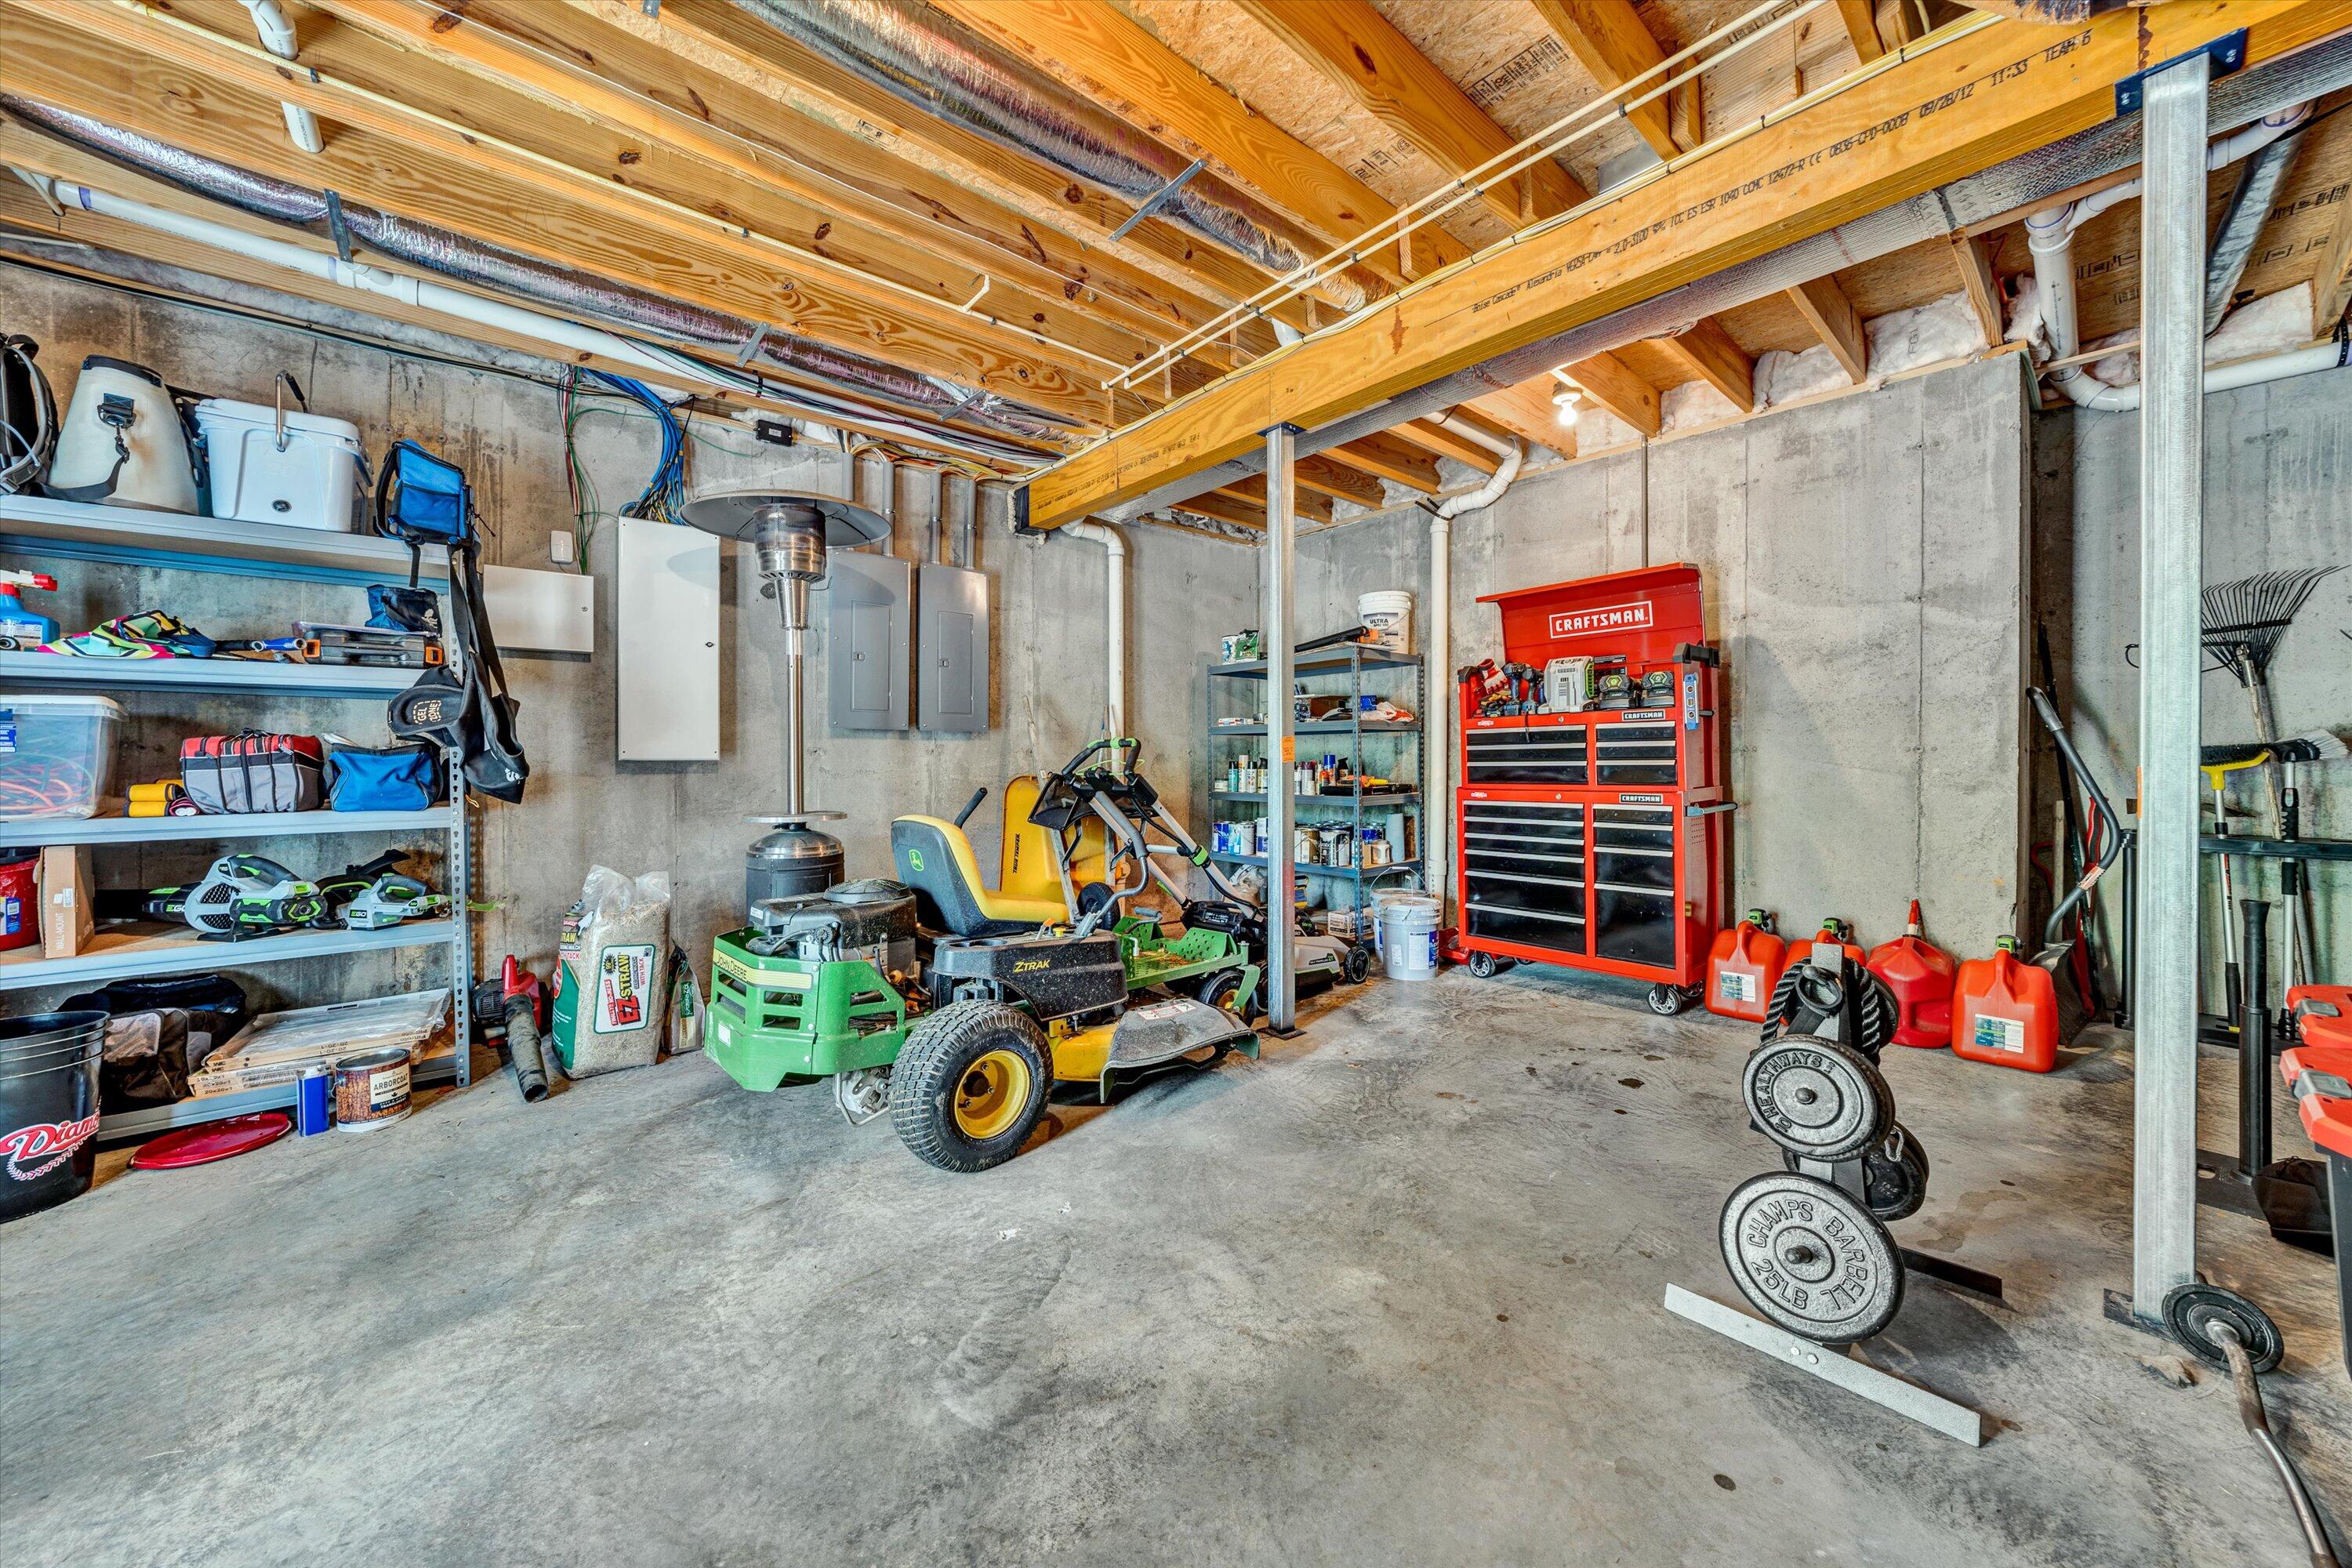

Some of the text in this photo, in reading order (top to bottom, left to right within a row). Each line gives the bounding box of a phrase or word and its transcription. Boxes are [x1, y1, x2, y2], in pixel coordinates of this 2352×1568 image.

[1526, 269, 1563, 292] Alexandria
[1686, 205, 1697, 221] ES
[1700, 198, 1715, 214] ESR
[1991, 58, 2029, 88] 11:33
[1555, 608, 1646, 632] CRAFTSMAN
[416, 707, 428, 721] GEL
[427, 703, 439, 721] ZONE
[1624, 711, 1664, 720] CRAFTSMAN
[56, 912, 65, 951] WALL-MOUNT
[717, 953, 747, 980] JOHN DEERE
[1014, 959, 1051, 974] ZTRAK
[373, 1073, 408, 1091] ARBORCOAT
[1756, 1051, 1823, 1133] HEALTHWAYS 10
[1747, 1199, 1868, 1311] CHAMPS BARBELL
